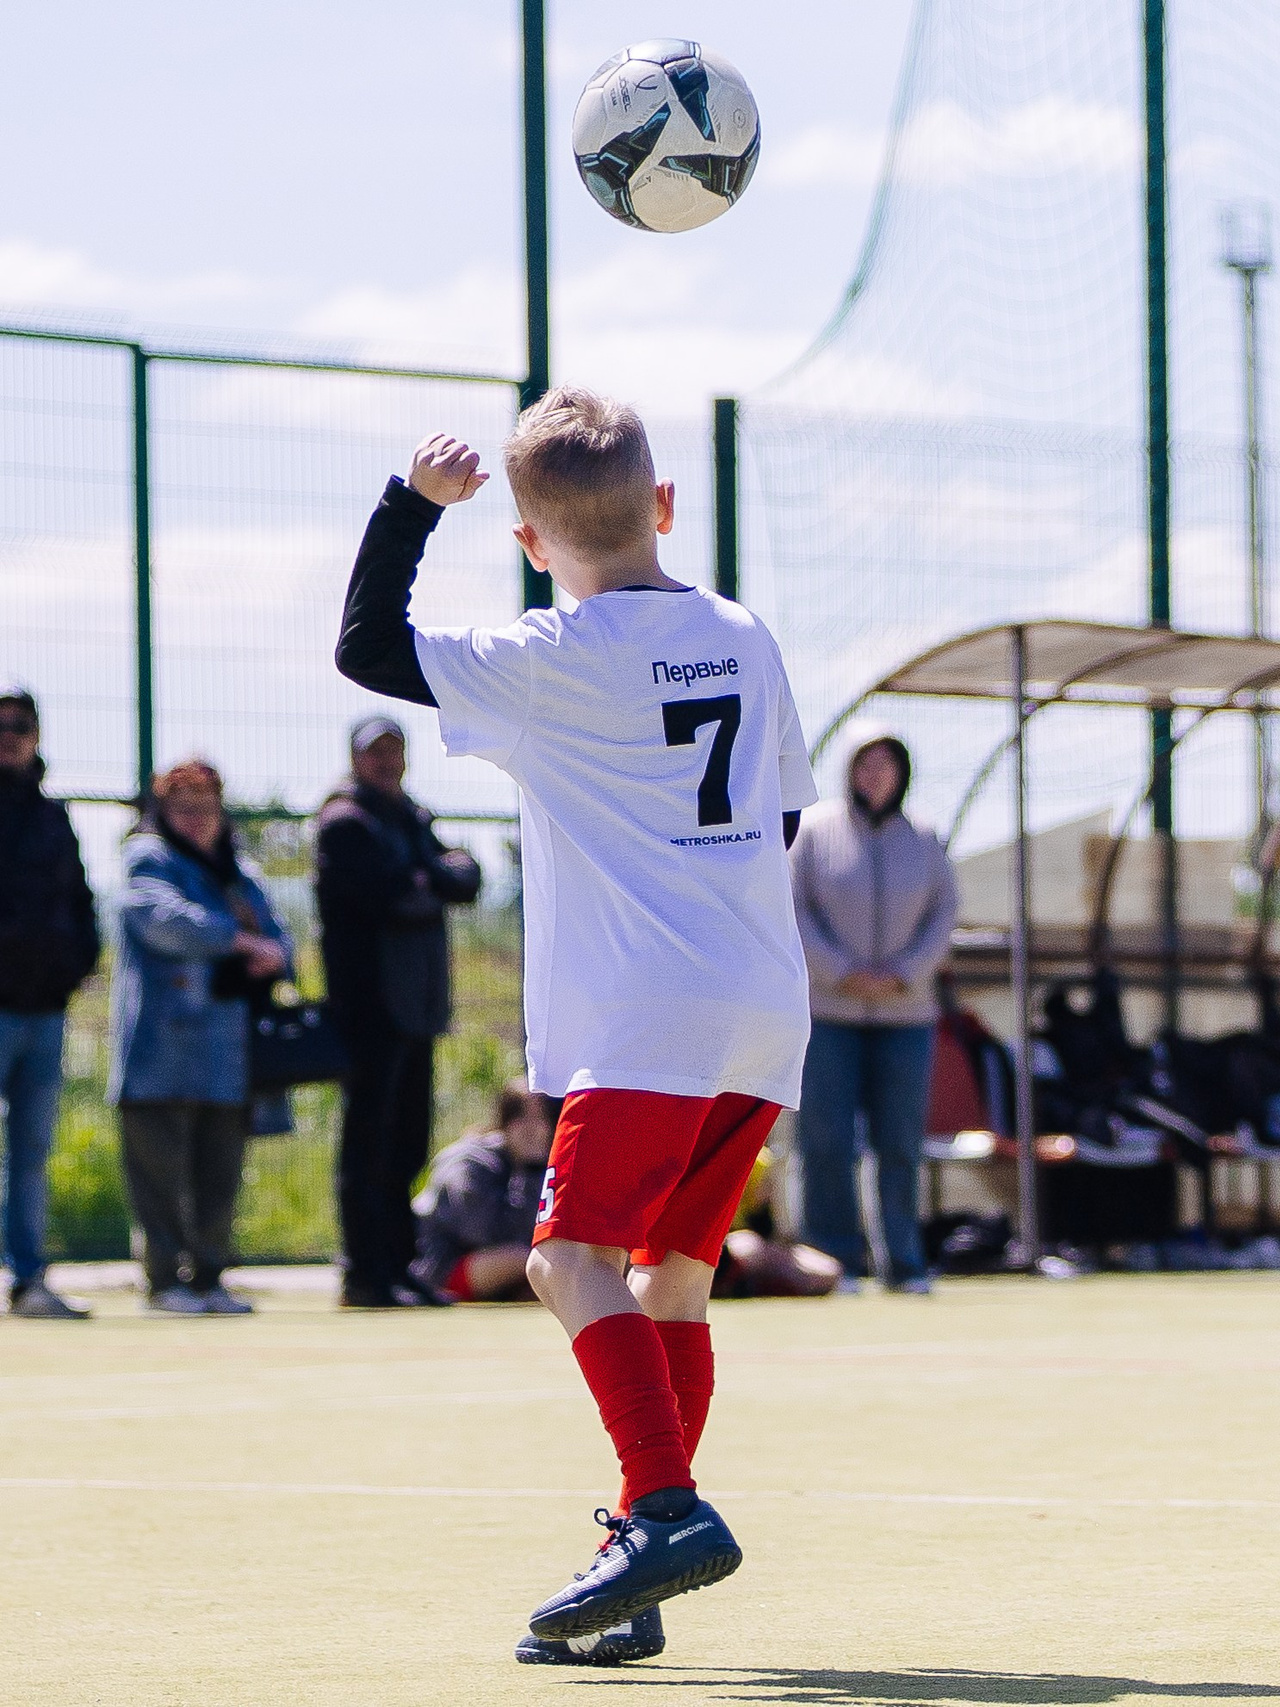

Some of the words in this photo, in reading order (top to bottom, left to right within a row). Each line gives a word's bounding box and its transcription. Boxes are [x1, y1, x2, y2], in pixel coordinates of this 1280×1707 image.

[652, 658, 738, 687] Первые
[661, 693, 742, 827] 7
[668, 1520, 715, 1545] MERCURIAL
